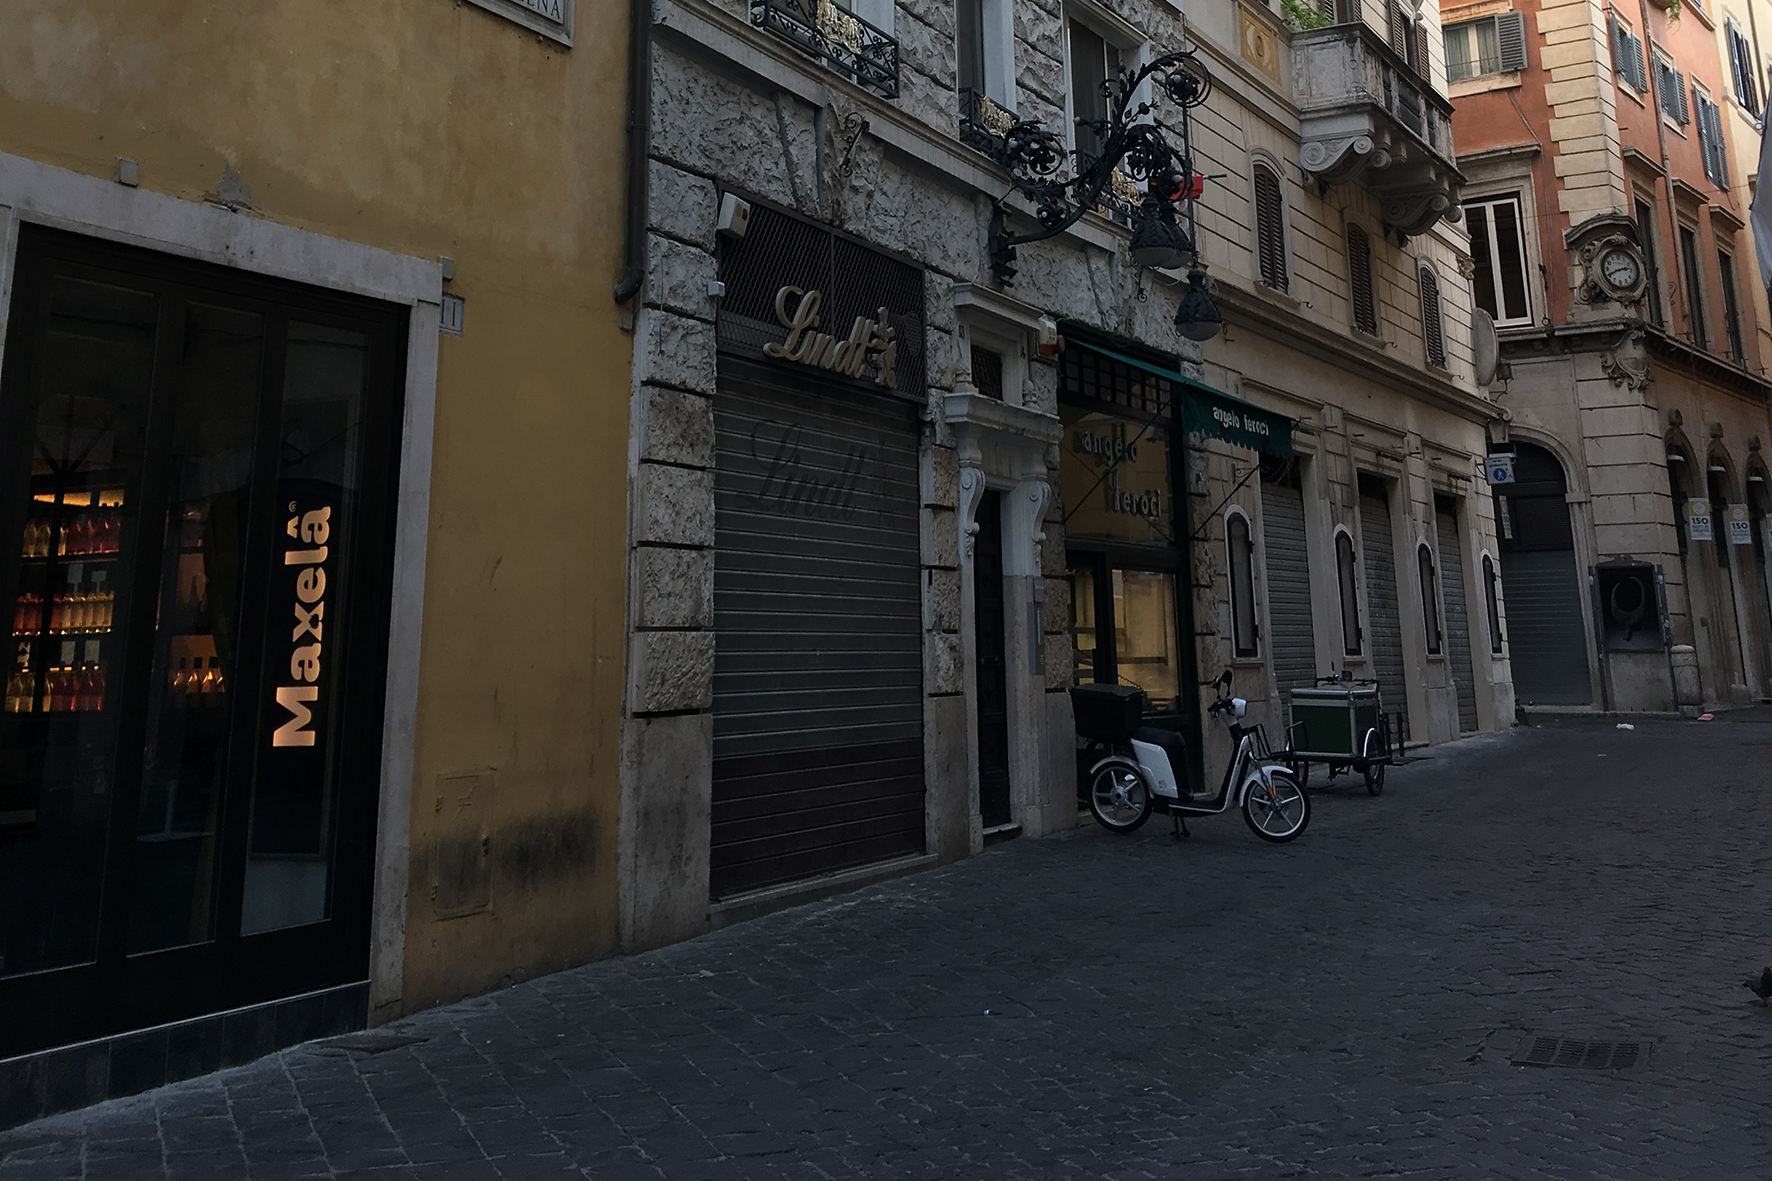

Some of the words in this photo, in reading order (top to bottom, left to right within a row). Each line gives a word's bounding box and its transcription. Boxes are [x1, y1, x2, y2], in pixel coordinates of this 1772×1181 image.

[763, 285, 875, 379] Lindt
[1212, 406, 1240, 428] angelo
[1243, 414, 1270, 436] feroci
[1081, 422, 1138, 467] angelo
[1691, 517, 1709, 525] 150
[1731, 522, 1748, 530] 150
